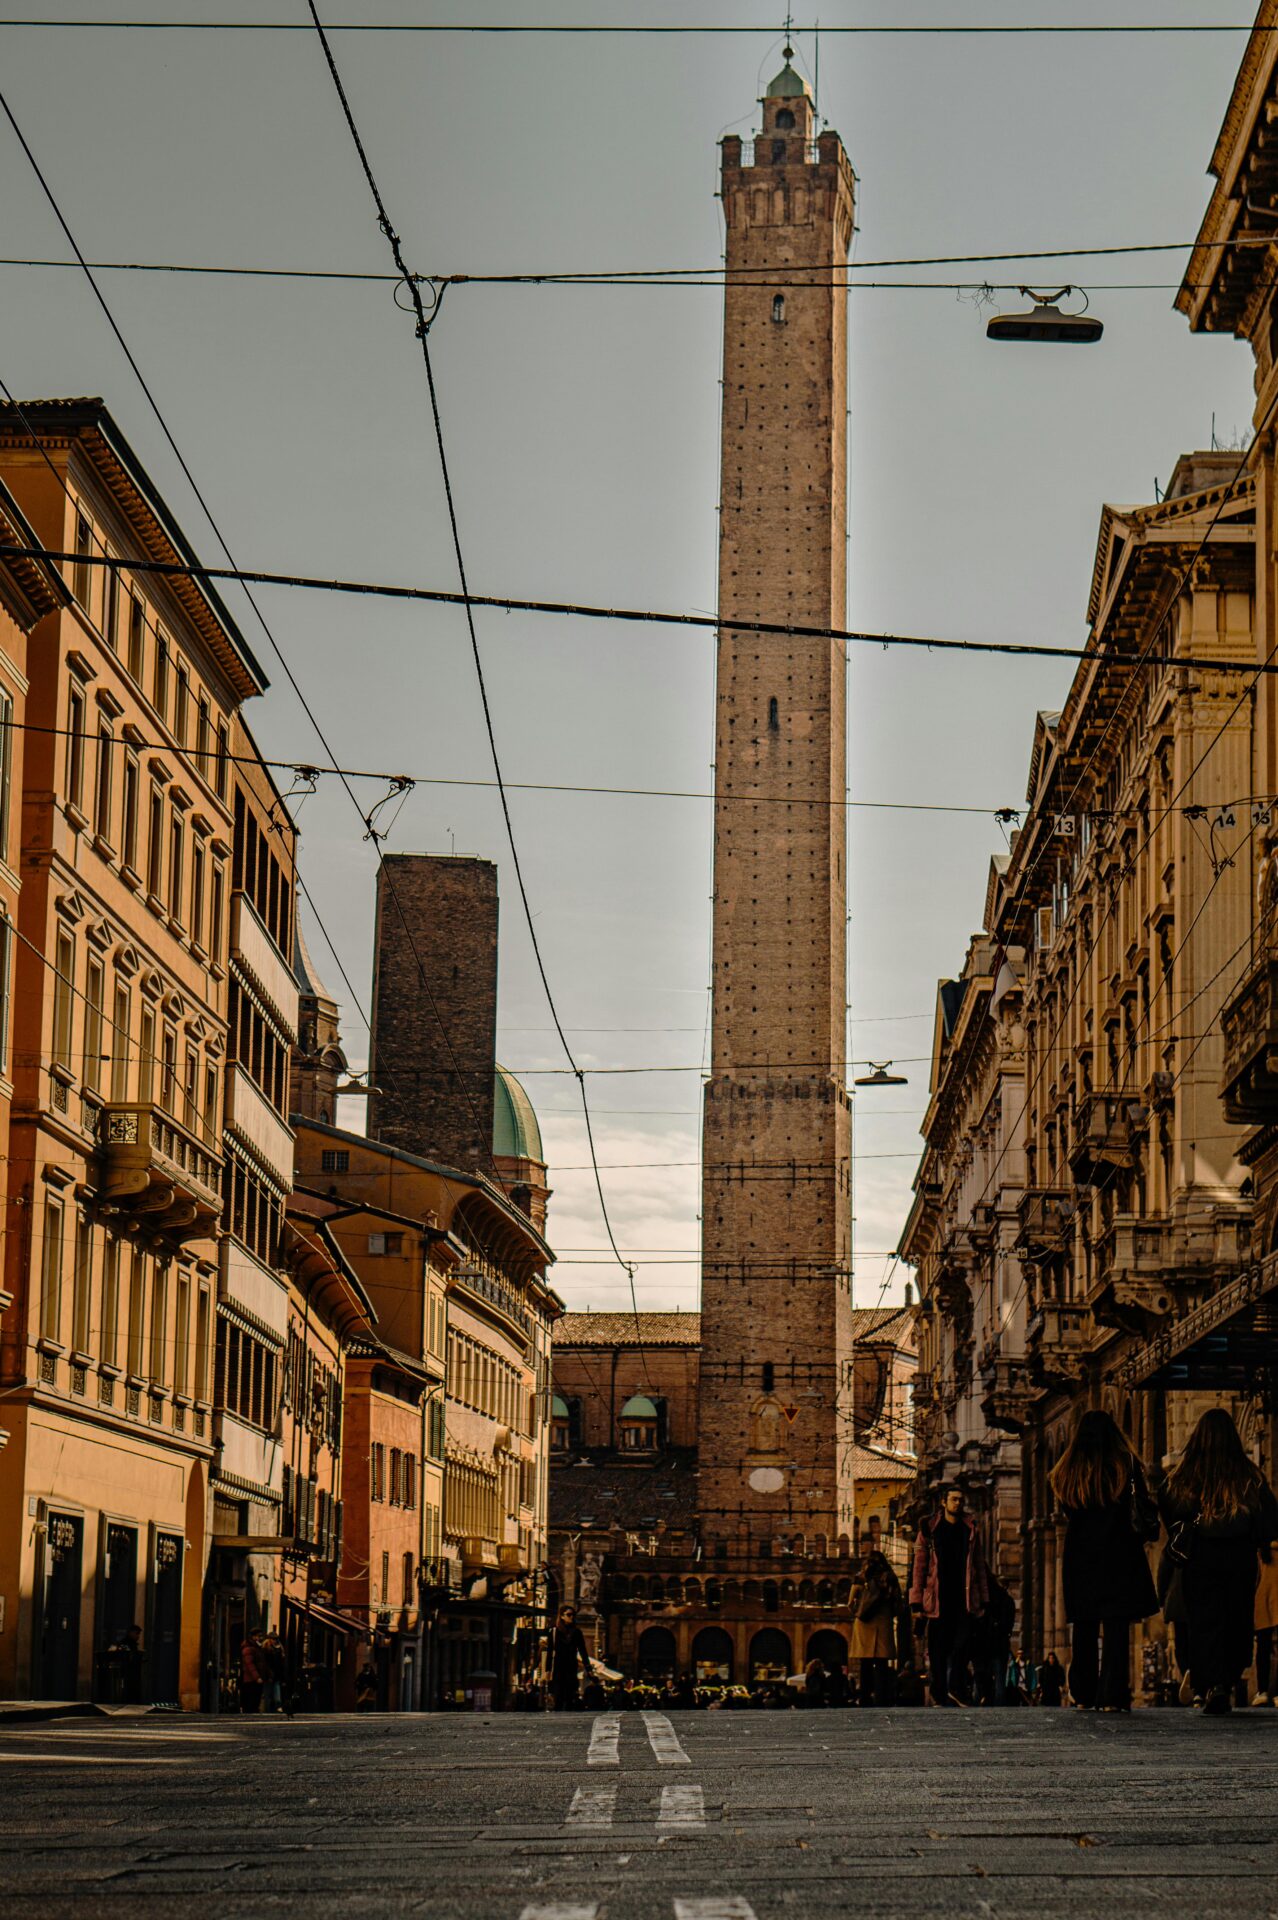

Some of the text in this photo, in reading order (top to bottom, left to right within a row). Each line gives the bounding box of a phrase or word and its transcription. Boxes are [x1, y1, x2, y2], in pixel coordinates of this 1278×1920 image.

[1216, 814, 1235, 827] 14
[1253, 812, 1270, 825] 15
[1057, 821, 1073, 833] 13
